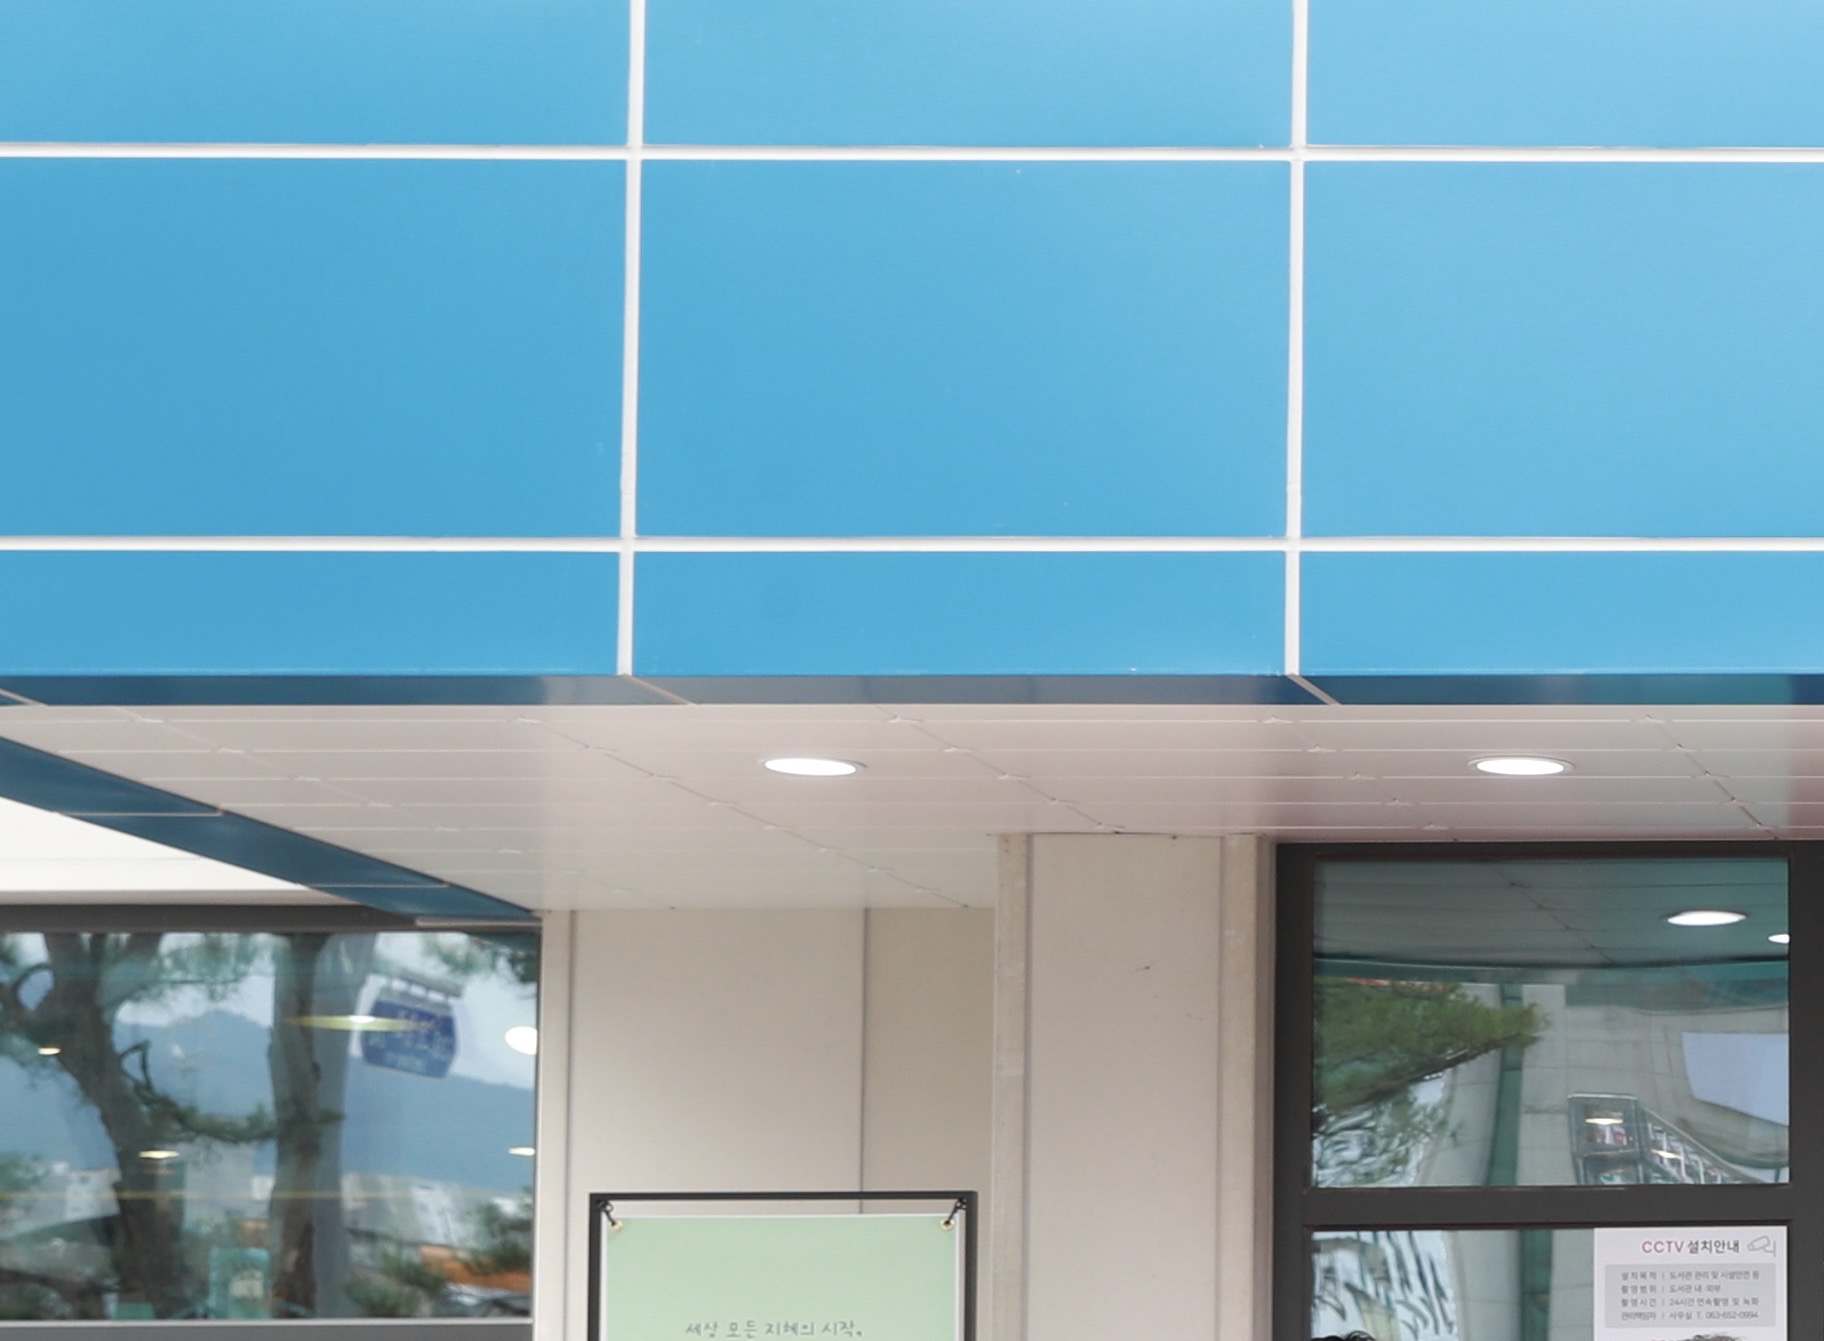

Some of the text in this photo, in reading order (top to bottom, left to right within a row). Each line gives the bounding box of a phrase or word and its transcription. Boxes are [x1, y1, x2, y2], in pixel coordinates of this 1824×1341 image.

[1642, 1239, 1740, 1255] CCTV 설치안내
[685, 1321, 718, 1338] 세상
[727, 1320, 758, 1338] 모든
[765, 1321, 814, 1336] 지혜의
